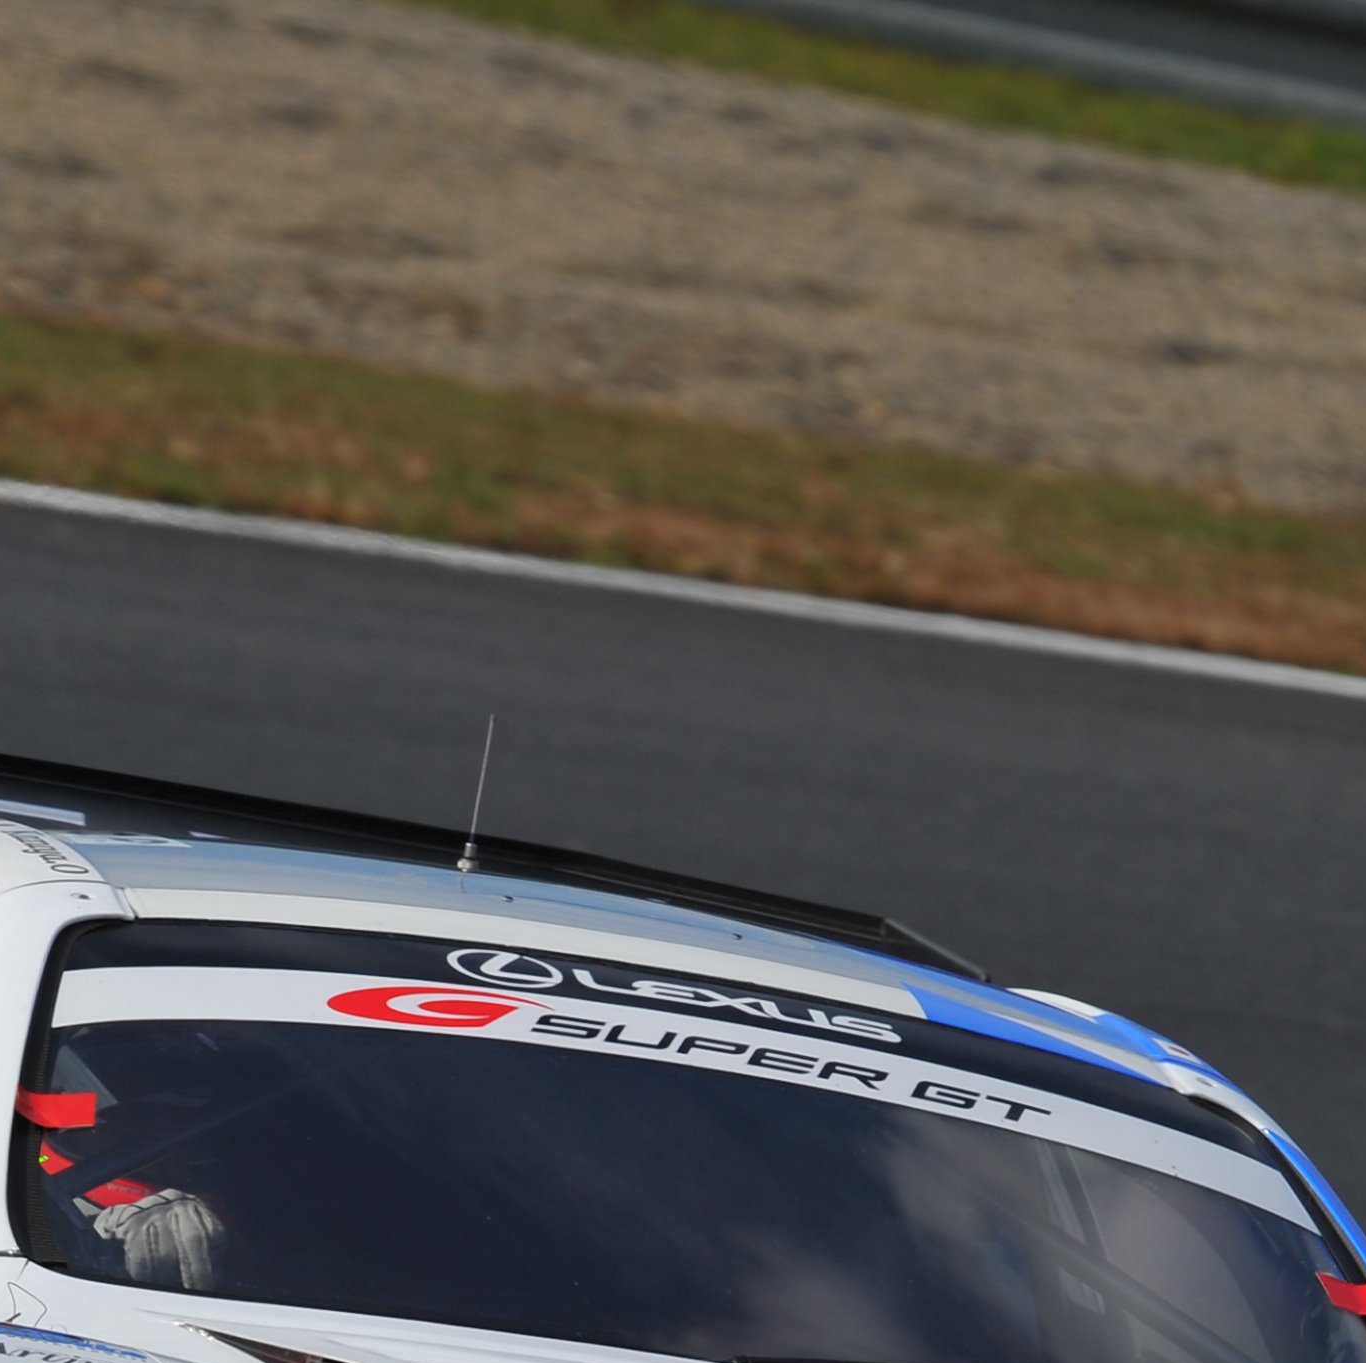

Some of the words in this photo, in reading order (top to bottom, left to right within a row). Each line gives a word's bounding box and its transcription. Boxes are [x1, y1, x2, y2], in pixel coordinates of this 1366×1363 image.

[571, 968, 903, 1044] LEXUS
[530, 1013, 890, 1091] SUPER
[910, 1080, 1052, 1123] GT
